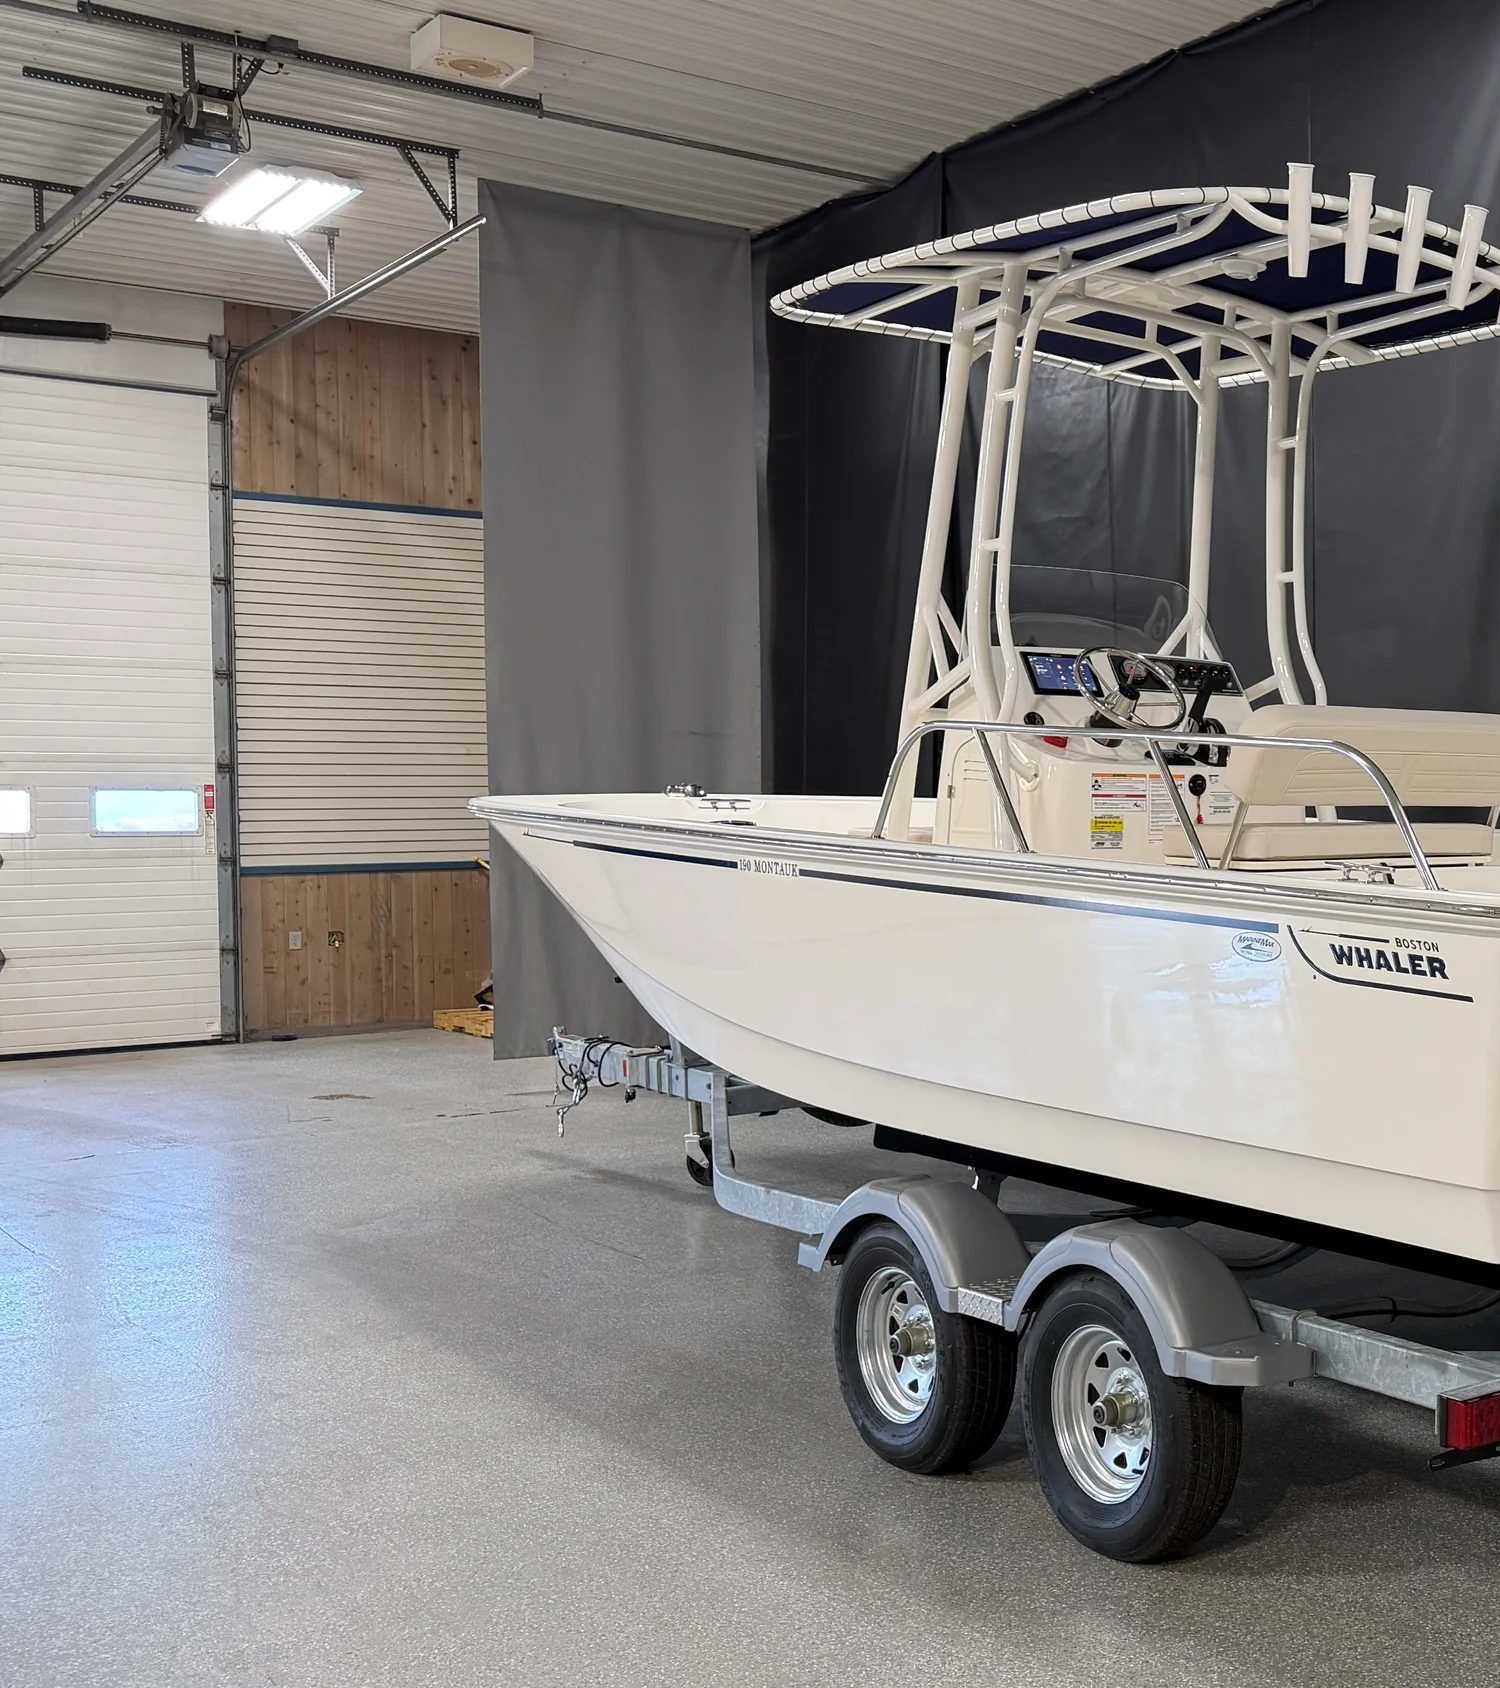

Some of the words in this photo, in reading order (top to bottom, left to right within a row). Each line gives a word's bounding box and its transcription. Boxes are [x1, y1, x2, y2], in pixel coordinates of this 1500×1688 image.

[739, 859, 752, 872] 190
[754, 859, 798, 877] MONTAUK
[1394, 937, 1440, 953] BOSTON
[1329, 943, 1450, 981] WHALER
